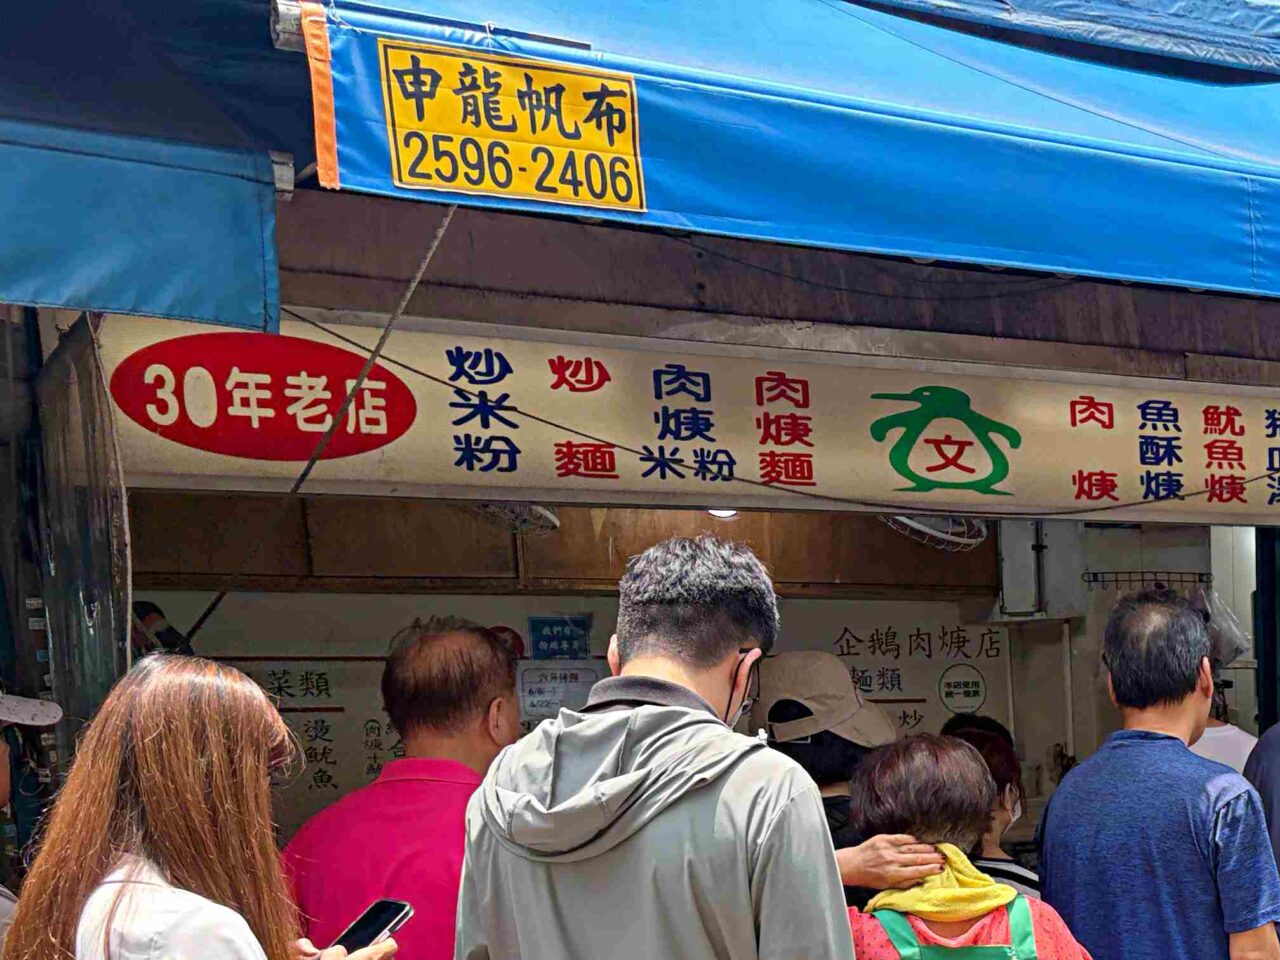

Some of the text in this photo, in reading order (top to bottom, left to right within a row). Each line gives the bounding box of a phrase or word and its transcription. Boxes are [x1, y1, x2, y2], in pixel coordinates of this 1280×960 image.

[392, 55, 628, 148] 申龍帆布
[403, 131, 633, 203] 2596-2406
[143, 363, 389, 437] 30年老店
[445, 346, 522, 473] 炒米粉
[548, 355, 620, 479] 炒麵
[755, 371, 817, 486] 肉焿麵
[923, 434, 976, 474] 文
[246, 669, 331, 698] 菜類
